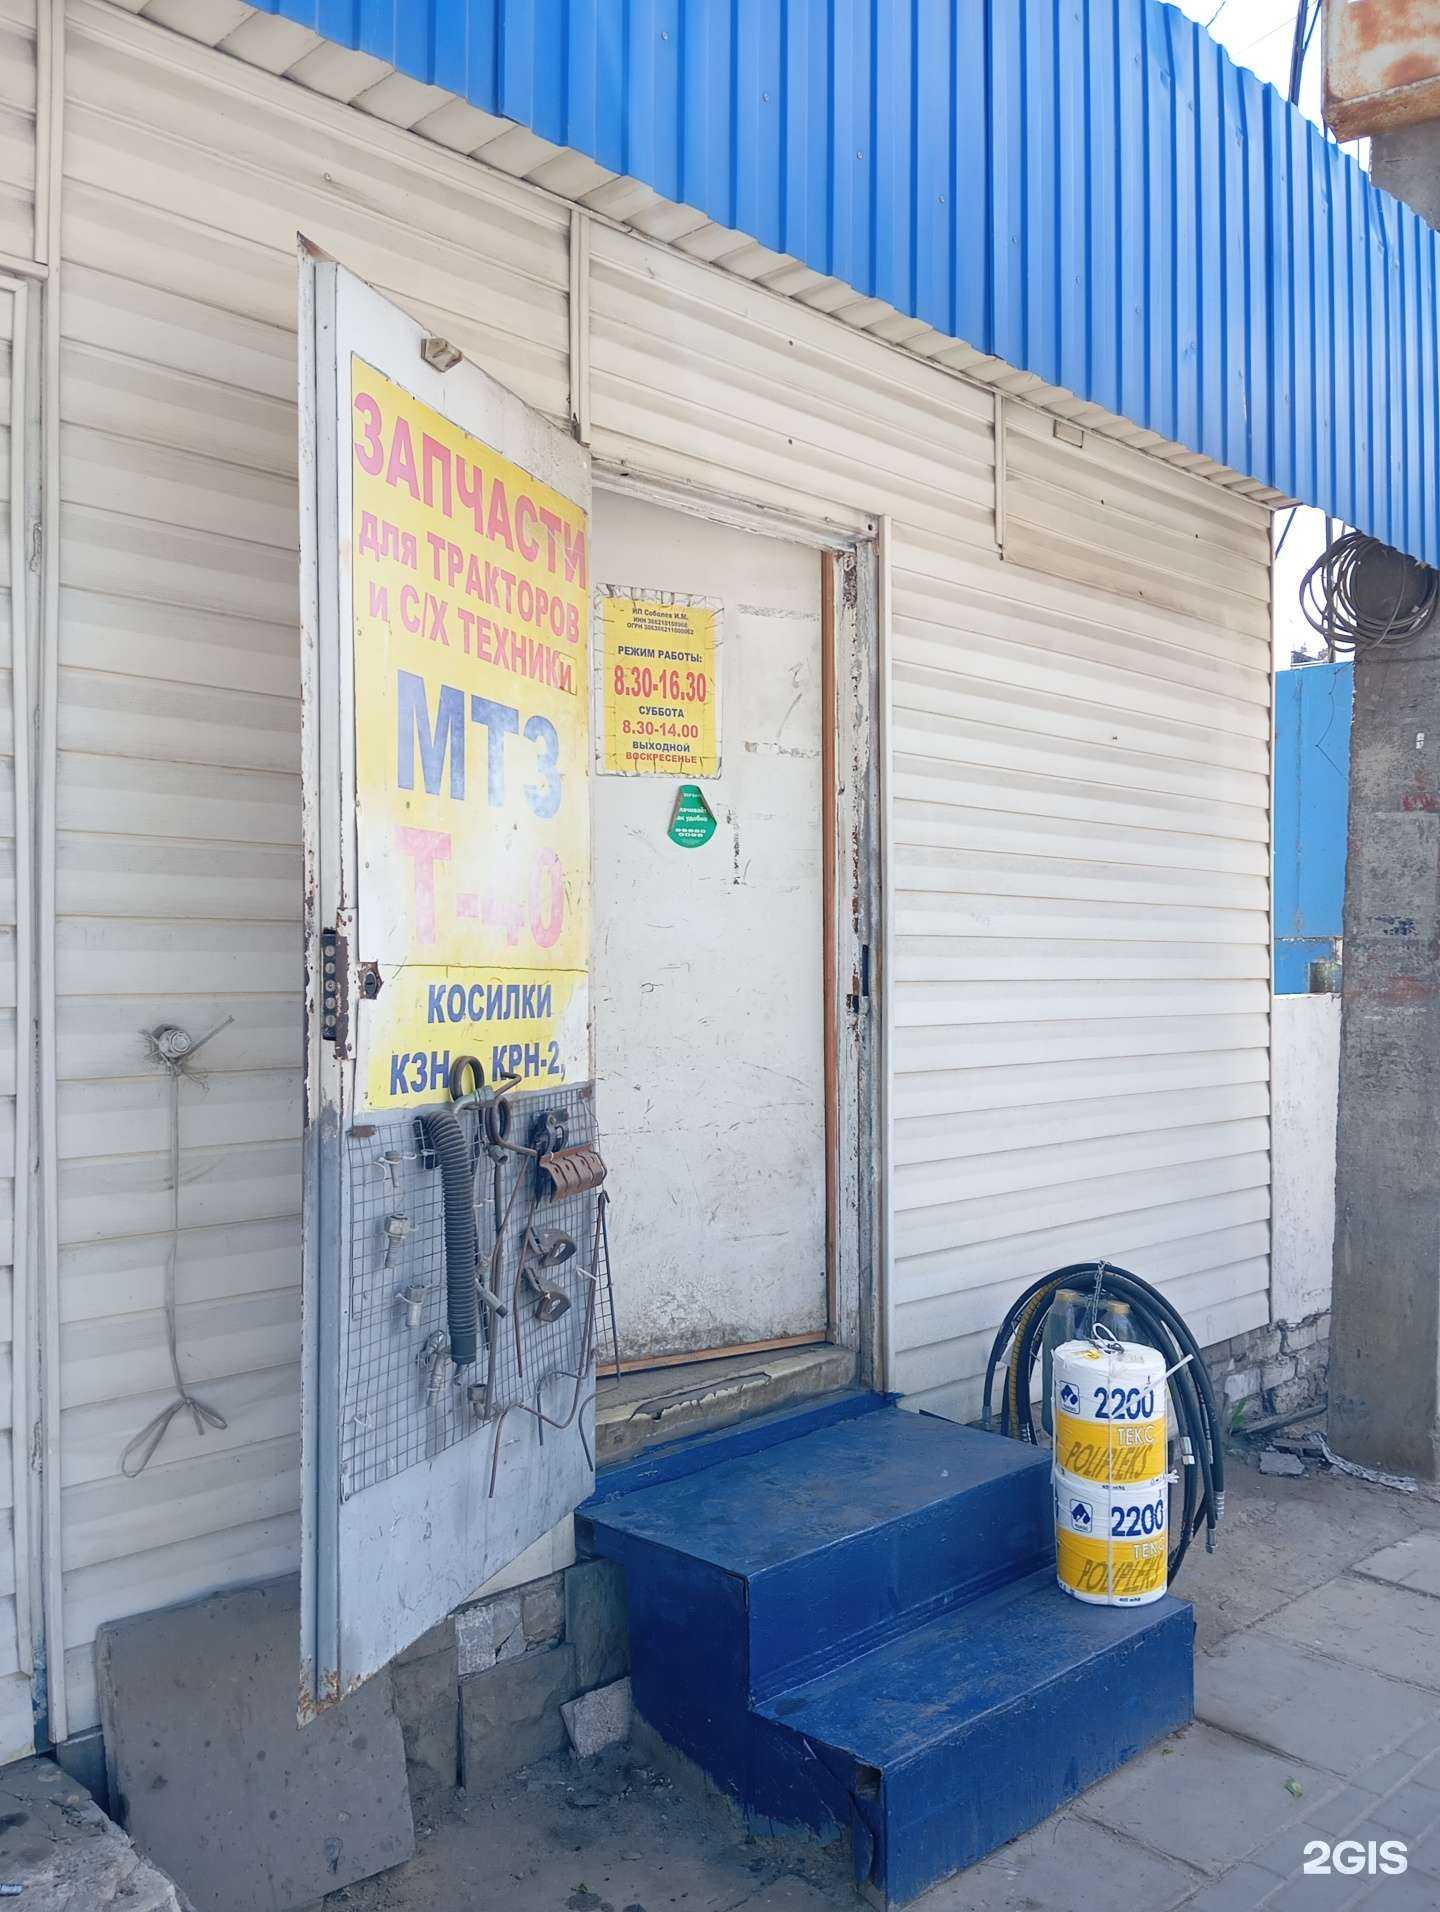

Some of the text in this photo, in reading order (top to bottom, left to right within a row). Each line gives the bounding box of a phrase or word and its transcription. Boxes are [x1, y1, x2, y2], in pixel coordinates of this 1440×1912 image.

[354, 392, 587, 590] ЗАПЧАСТИ
[359, 510, 579, 643] ДЛЯ ТРАКТОРОВ
[369, 581, 389, 623] И
[400, 584, 450, 646] С/Х
[618, 645, 703, 663] РЕЖИМ РАБОТЫ:
[614, 665, 707, 703] 8.30-16.30
[622, 720, 699, 738] 8.30-14.00
[639, 706, 684, 718] СУББОТА
[397, 669, 561, 819] МТЗ
[626, 752, 697, 764] ВОСКРЕСЕНЬЕ
[632, 741, 690, 752] ВЫХОДНОЙ
[427, 983, 552, 1024] КОСИЛКИ
[1094, 1387, 1154, 1420] 2200
[1111, 1498, 1164, 1537] 2200
